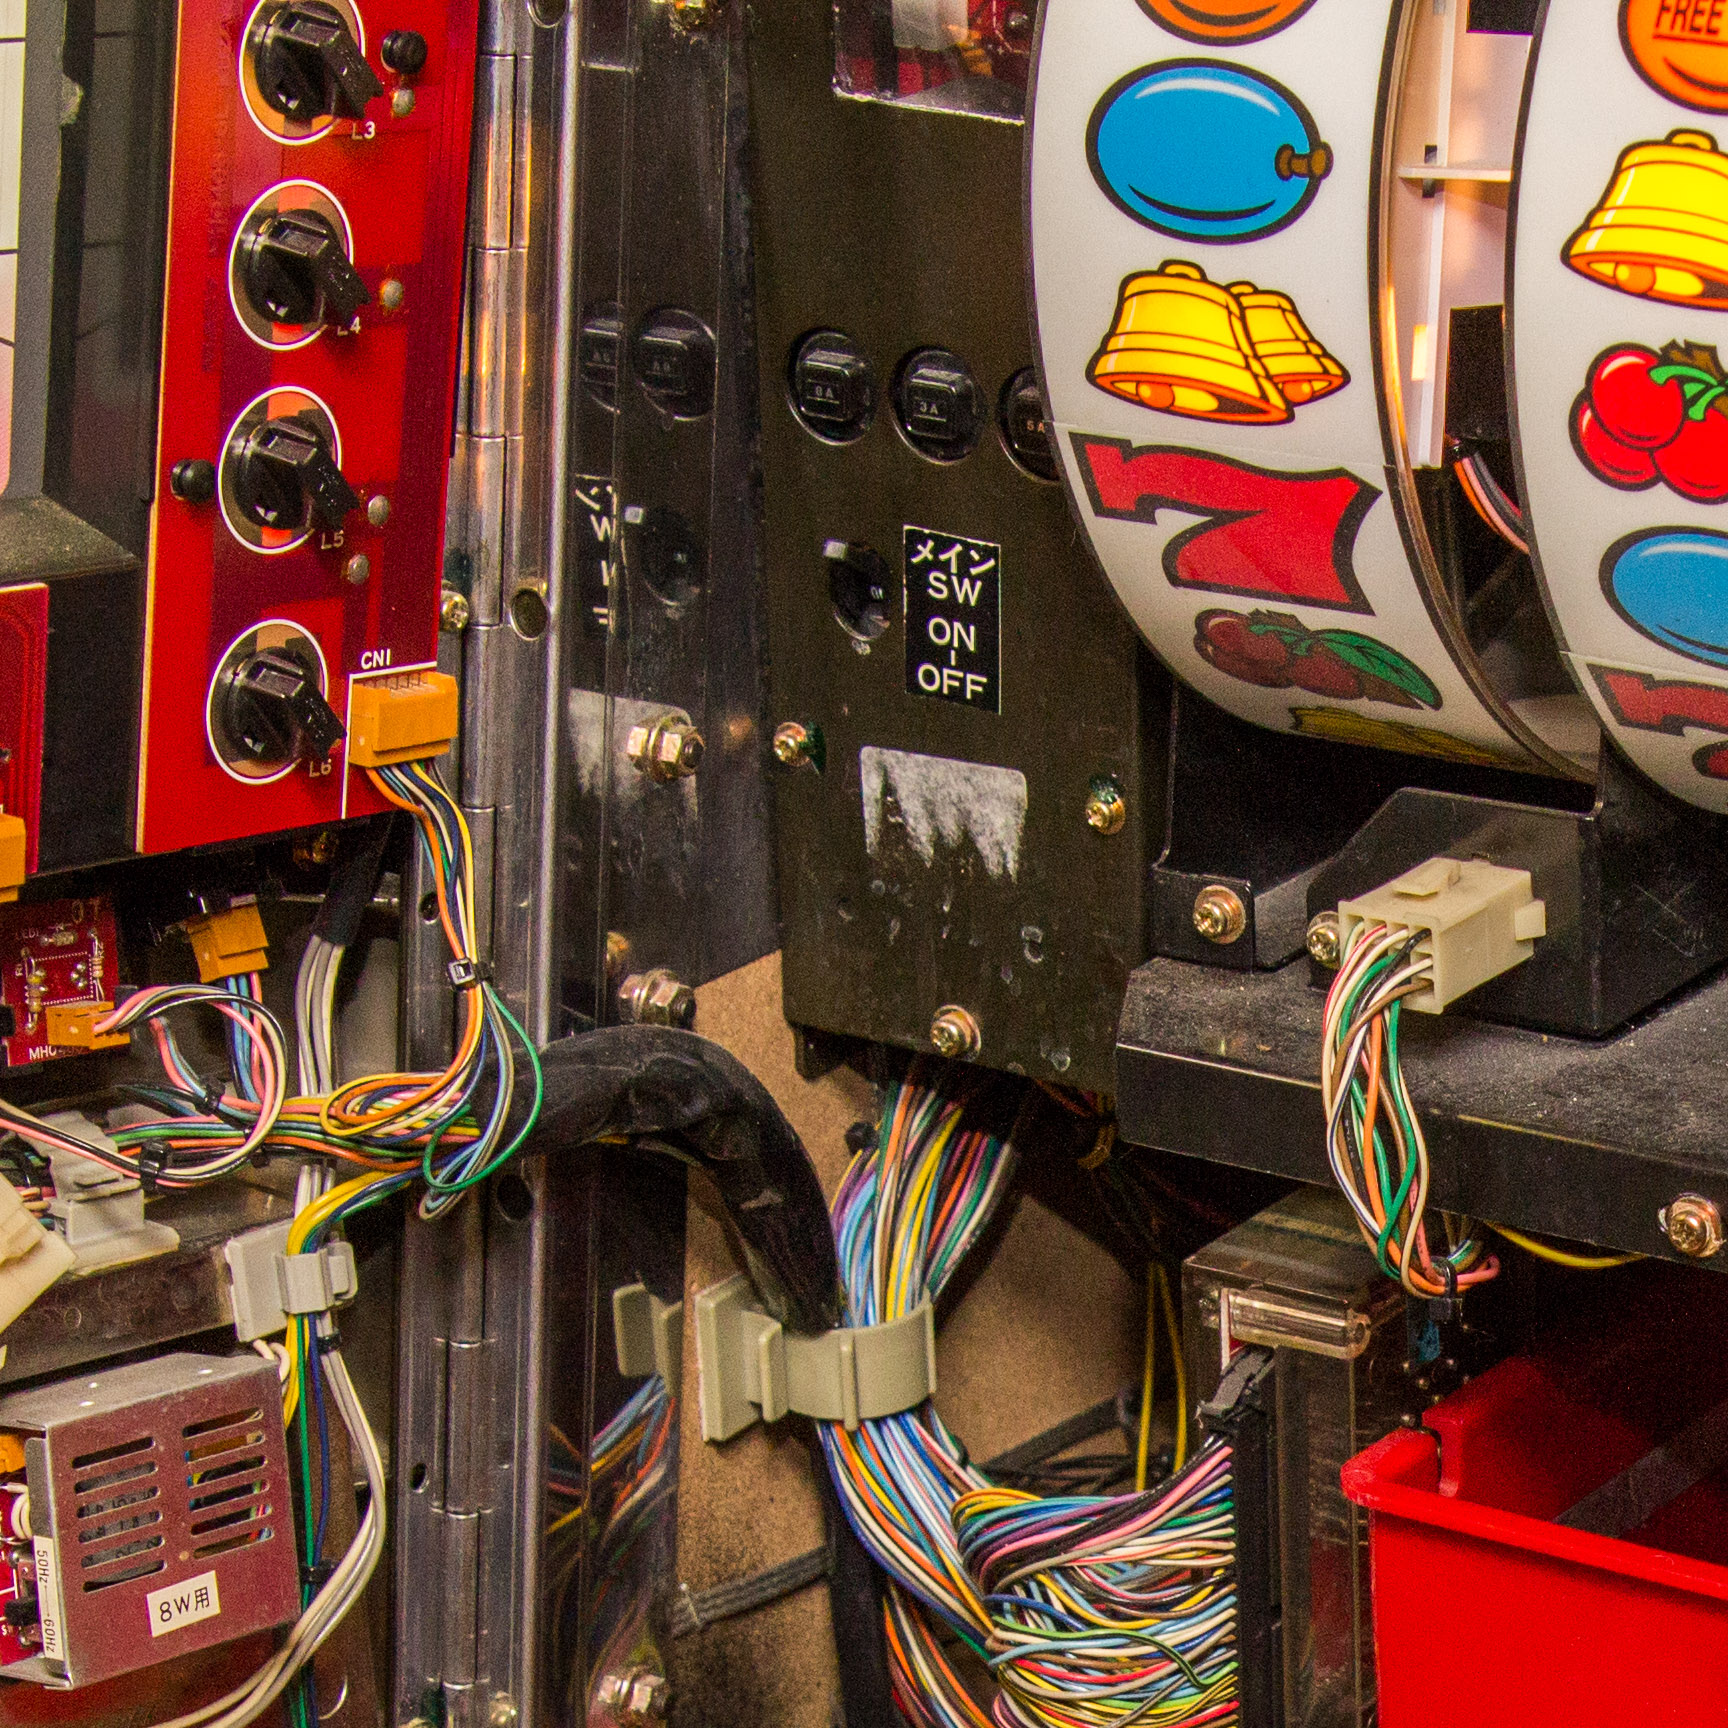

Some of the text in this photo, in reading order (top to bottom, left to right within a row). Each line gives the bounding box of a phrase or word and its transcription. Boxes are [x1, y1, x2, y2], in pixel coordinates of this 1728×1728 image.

[1655, 0, 1724, 36] FREE
[351, 120, 376, 140] L3
[320, 529, 344, 550] L5
[910, 538, 996, 576] メイン
[927, 571, 982, 607] SW
[928, 616, 976, 652] ON
[917, 663, 988, 700] OFF
[36, 1549, 57, 1653] 50Hz 60Hz
[159, 1586, 210, 1623] 8W用
